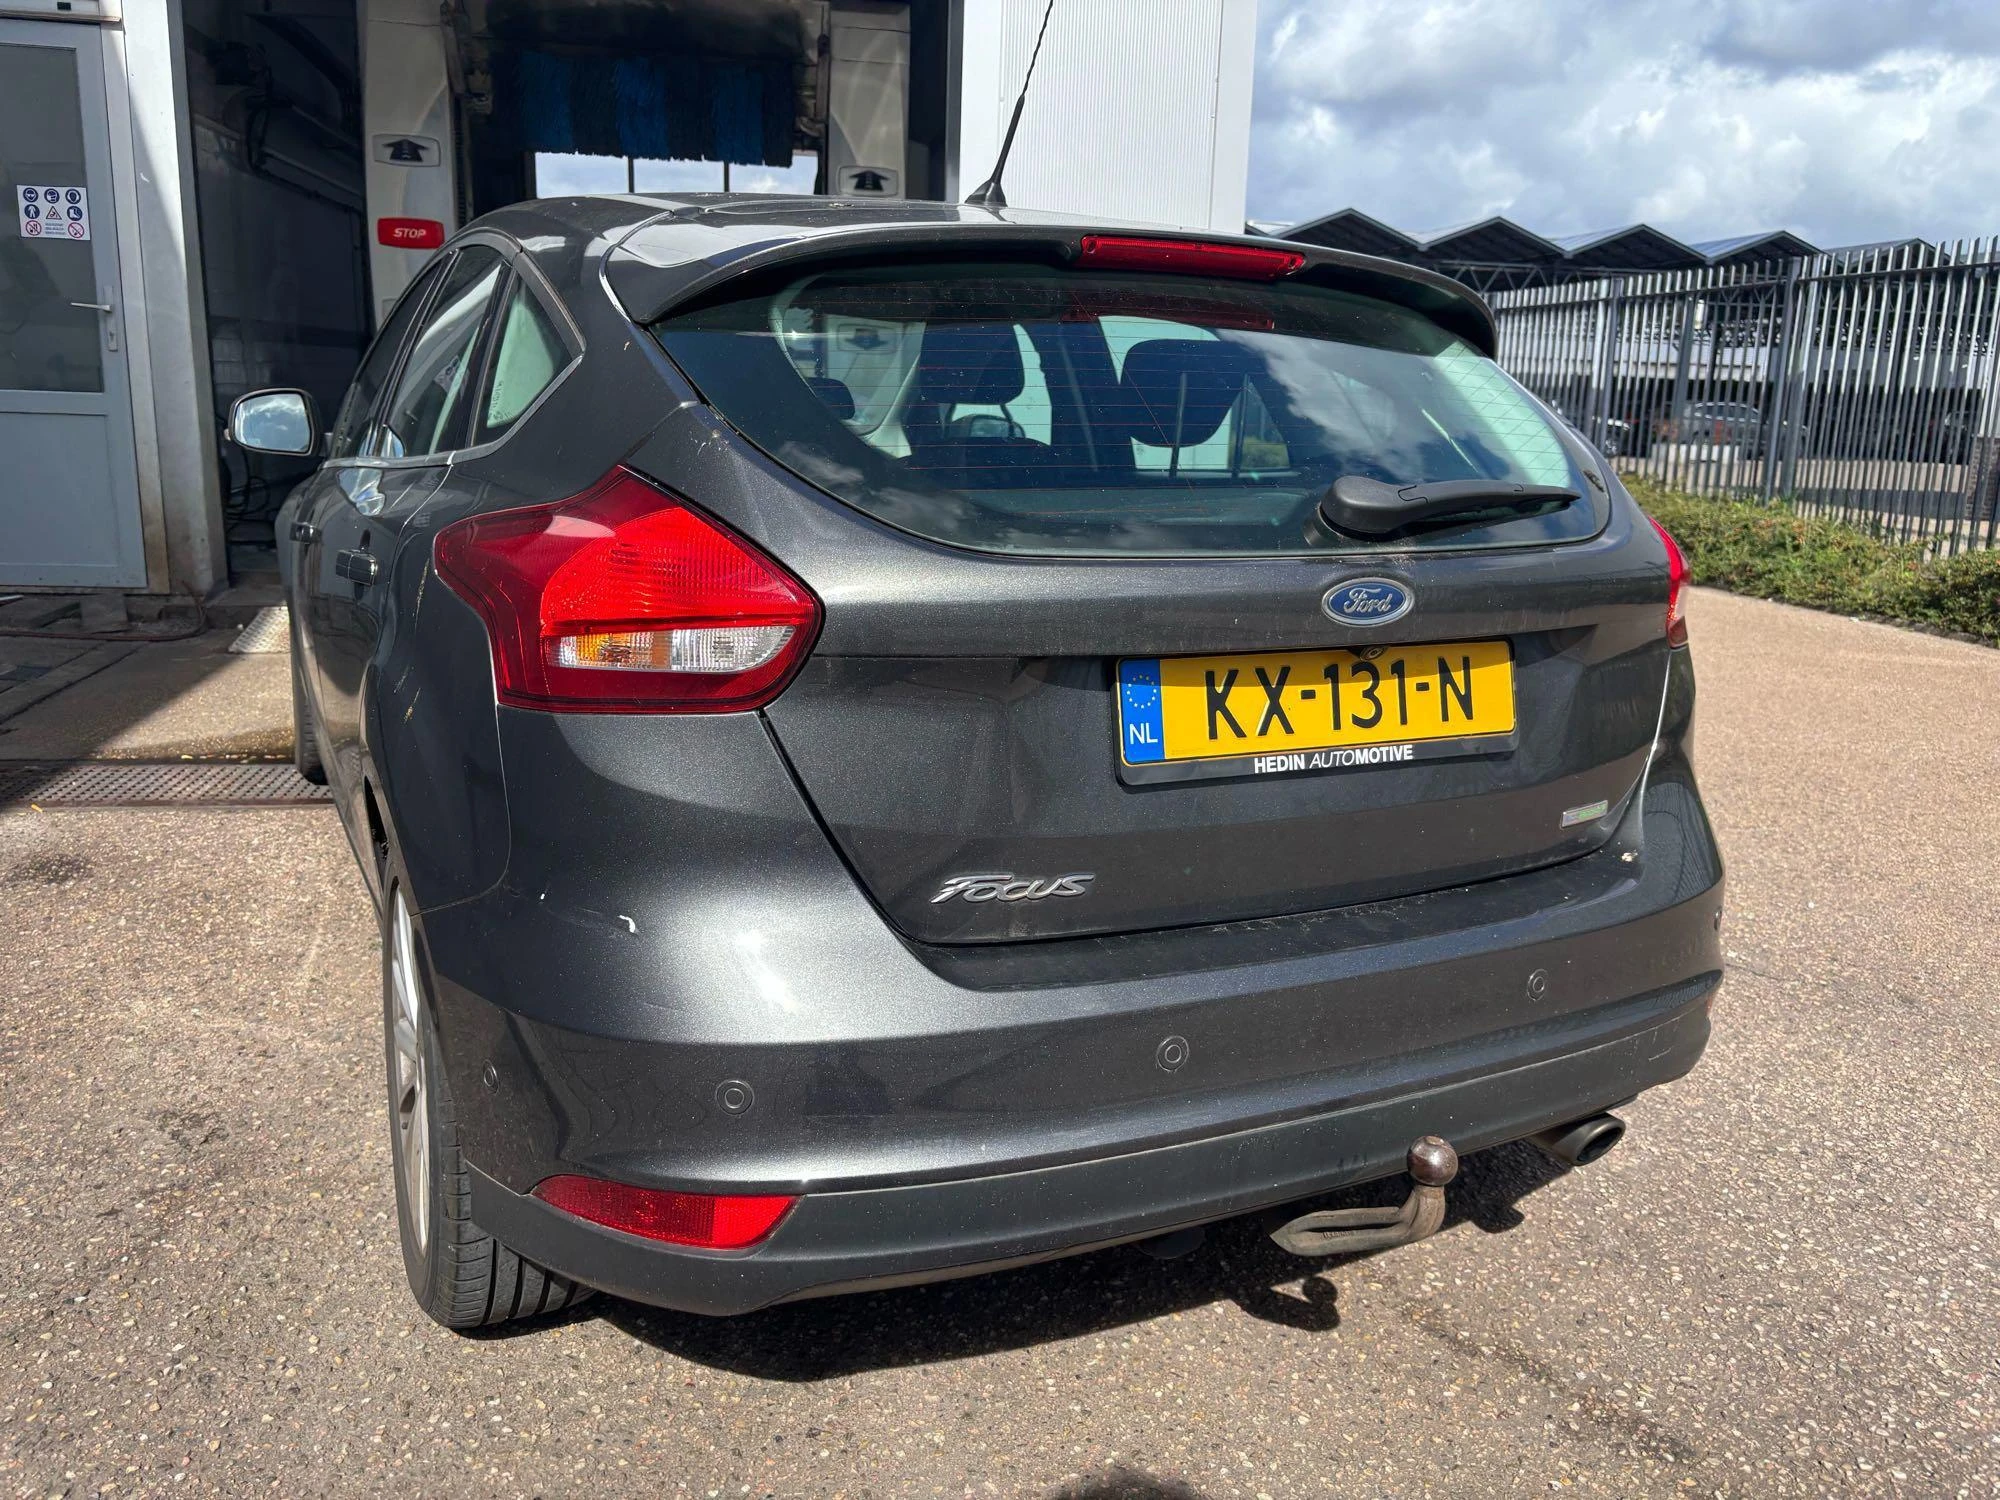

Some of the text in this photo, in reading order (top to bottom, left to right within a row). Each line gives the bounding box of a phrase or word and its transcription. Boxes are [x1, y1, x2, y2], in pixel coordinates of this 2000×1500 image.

[393, 227, 427, 239] STOP
[1343, 587, 1393, 613] Ford
[1205, 656, 1474, 740] KX-131-N
[1129, 722, 1158, 745] NL
[1254, 744, 1414, 774] HEDIN AUTOMOTIVE
